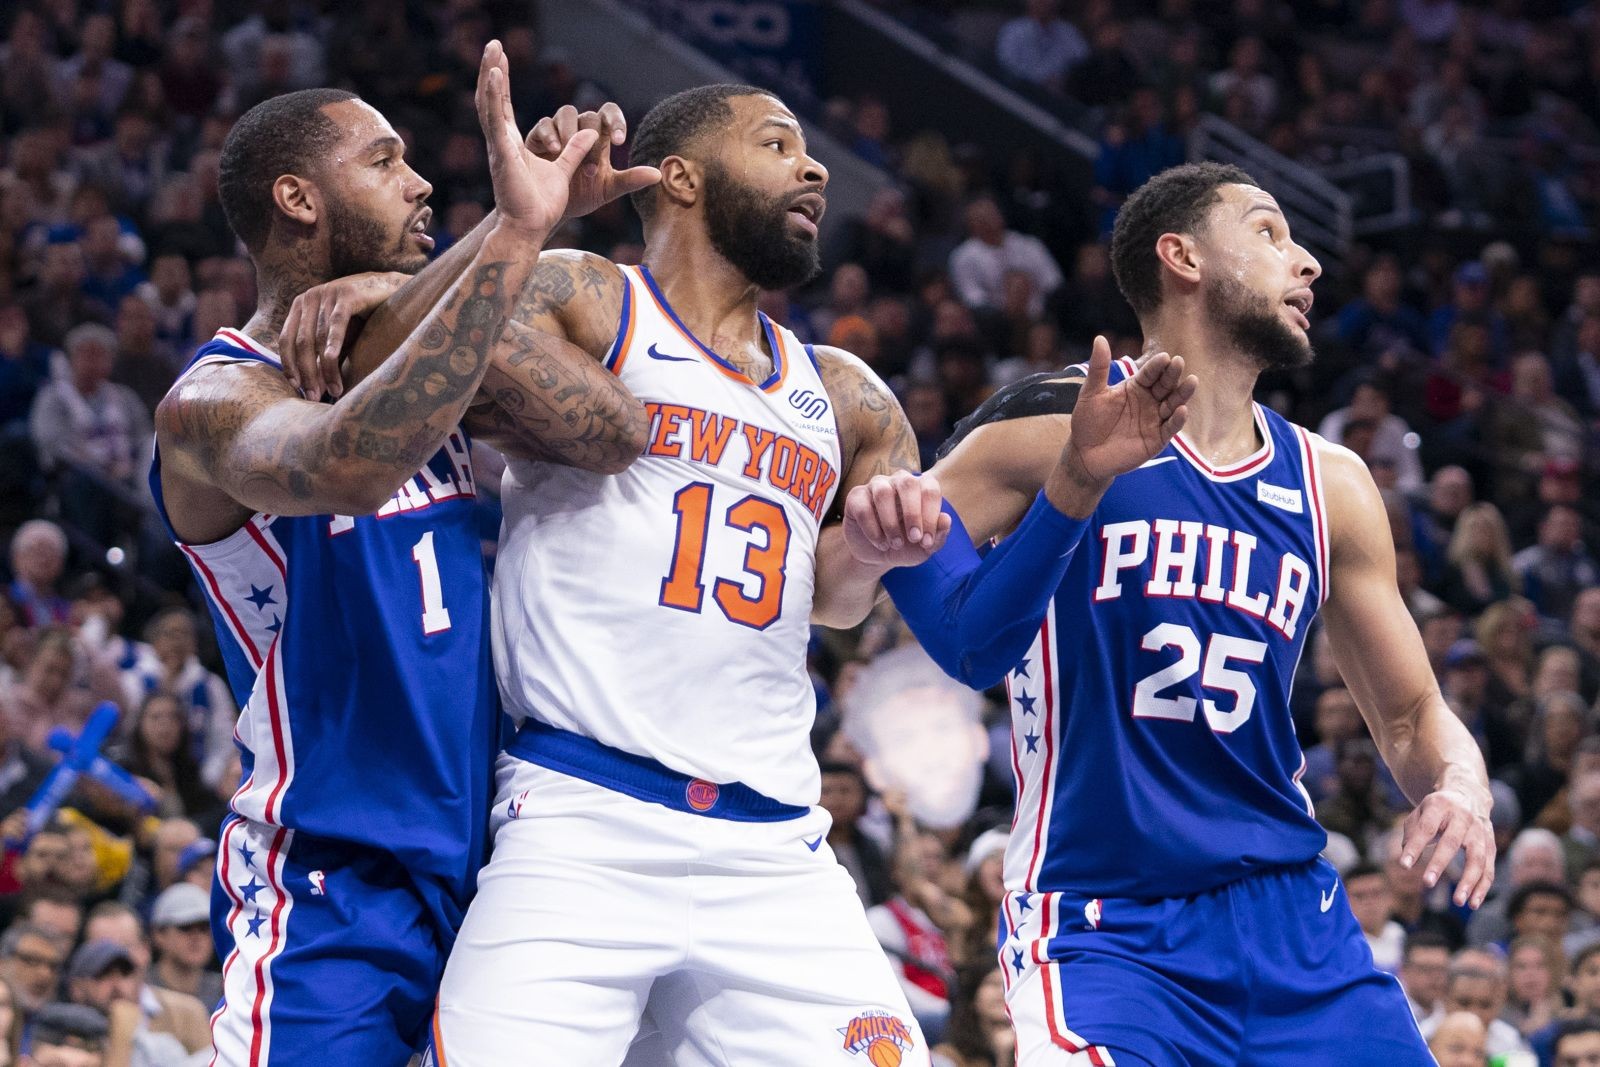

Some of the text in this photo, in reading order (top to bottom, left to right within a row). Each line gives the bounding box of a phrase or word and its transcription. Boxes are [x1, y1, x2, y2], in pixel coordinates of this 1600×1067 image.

[741, 423, 836, 524] YORK
[792, 421, 838, 435] ARESPAC
[1261, 488, 1295, 505] StubHub
[411, 530, 451, 635] 1
[658, 481, 792, 630] 13
[1094, 520, 1311, 641] PHILA
[1131, 622, 1268, 734] 25
[844, 1017, 914, 1055] KNICKS
